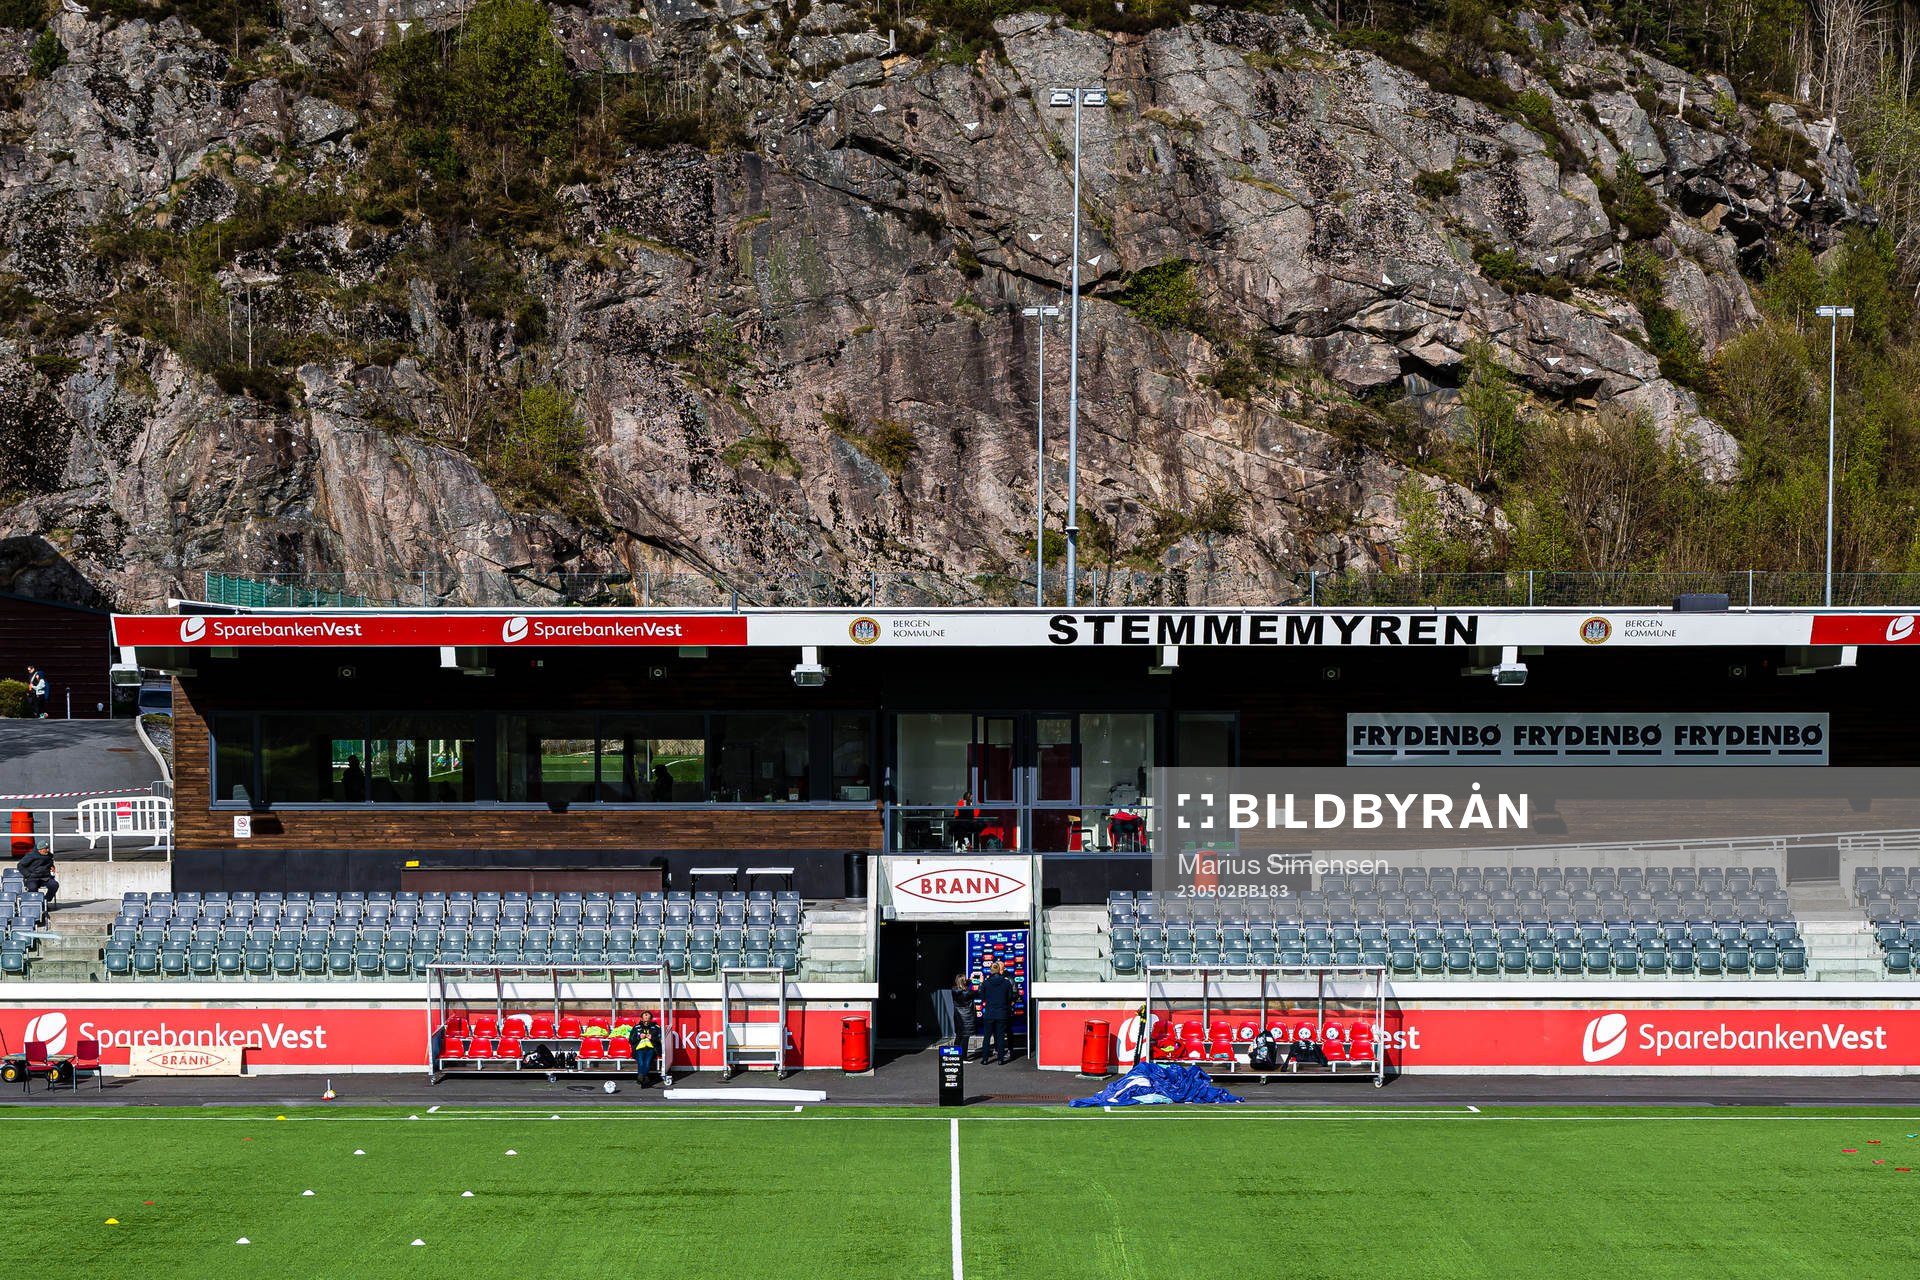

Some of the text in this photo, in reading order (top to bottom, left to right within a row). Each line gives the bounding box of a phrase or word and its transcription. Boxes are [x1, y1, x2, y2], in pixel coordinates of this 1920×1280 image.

[213, 620, 363, 642] SparebankenVest
[534, 620, 683, 642] SparebankenVest
[893, 619, 931, 628] BERGEN
[1048, 614, 1479, 645] STEMMEMYREN
[1625, 619, 1663, 628] BERGEN
[893, 629, 945, 638] KOMMUNE
[1624, 629, 1677, 638] KOMMUNE
[1353, 723, 1823, 749] FRYDENBØ FRYDENBØ FRYDENBØ
[920, 878, 1000, 894] BRANN
[1639, 1023, 1888, 1056] SparebankenVest
[161, 1055, 210, 1066] BRANN
